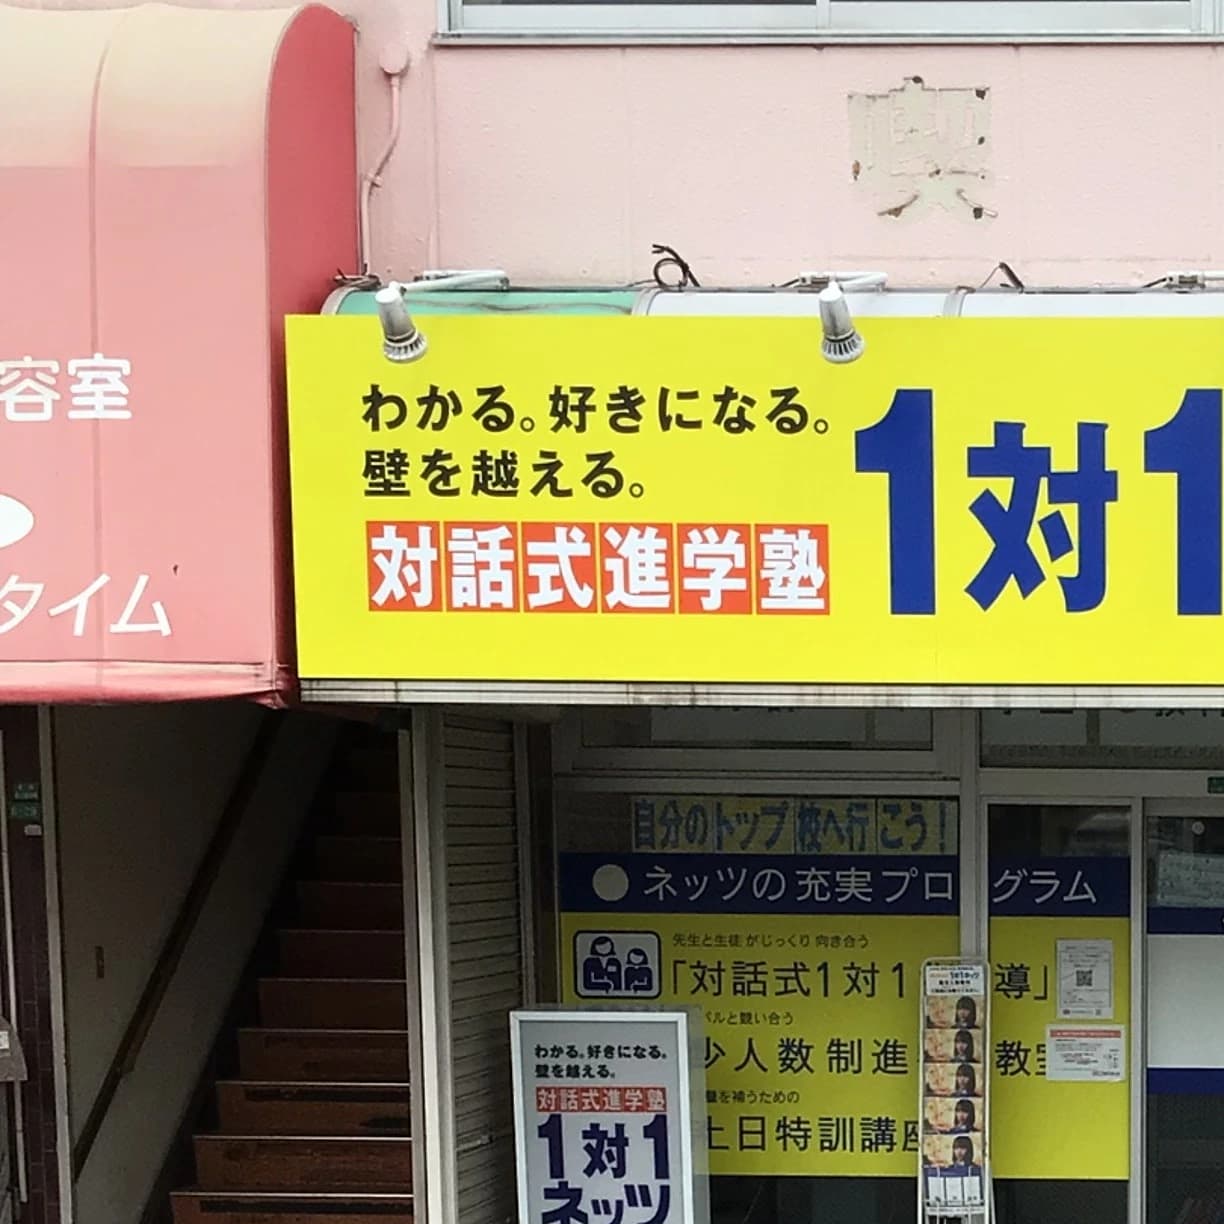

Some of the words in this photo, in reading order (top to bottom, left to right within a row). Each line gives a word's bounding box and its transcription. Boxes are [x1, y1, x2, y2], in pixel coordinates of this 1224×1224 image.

[0, 353, 132, 421] 容室
[362, 384, 828, 434] わかる。好きになる。
[362, 448, 644, 498] 壁を越える。
[371, 525, 826, 611] 対話式進学塾
[0, 573, 172, 637] タイム
[535, 1045, 667, 1060] わかる。好きになる。
[537, 1088, 667, 1112] 対話式進学塾
[537, 1114, 670, 1180] 1対1
